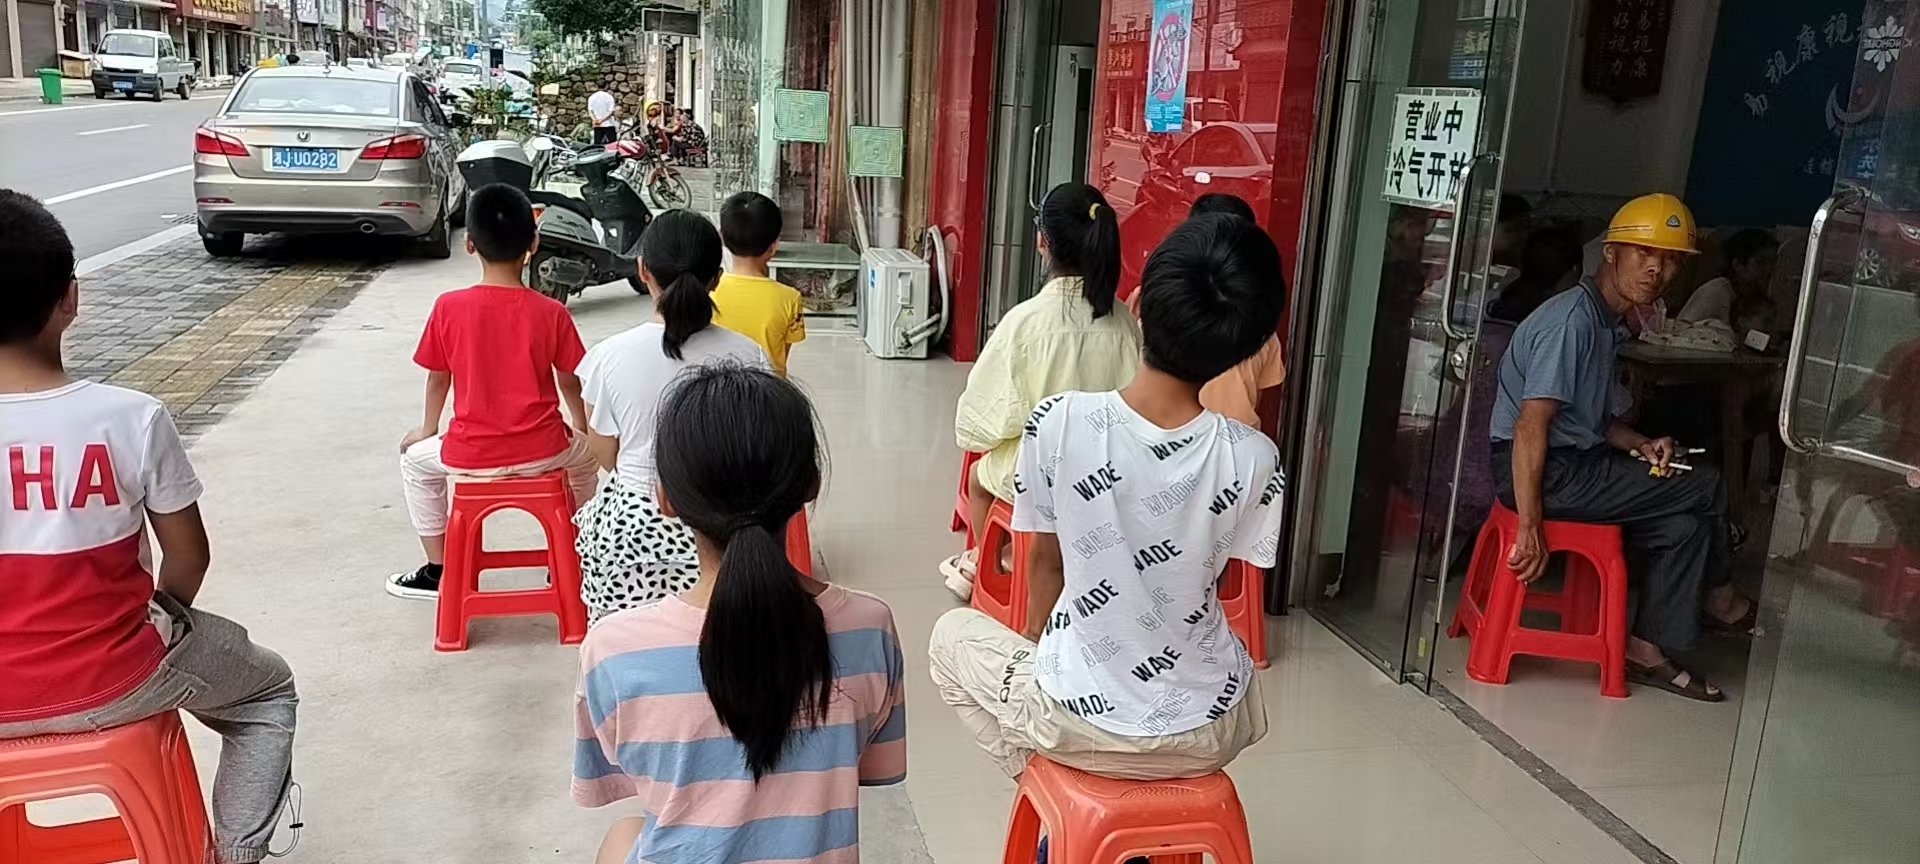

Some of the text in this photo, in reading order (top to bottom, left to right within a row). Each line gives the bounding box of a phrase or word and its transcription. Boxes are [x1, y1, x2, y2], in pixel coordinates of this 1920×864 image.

[1405, 99, 1463, 144] 营业中
[1389, 146, 1466, 200] 冷气开放
[9, 442, 120, 510] HA
[1072, 460, 1123, 502] WADE
[1141, 472, 1200, 517] WADE
[1072, 578, 1119, 619] WADE
[1137, 688, 1192, 736] WADE
